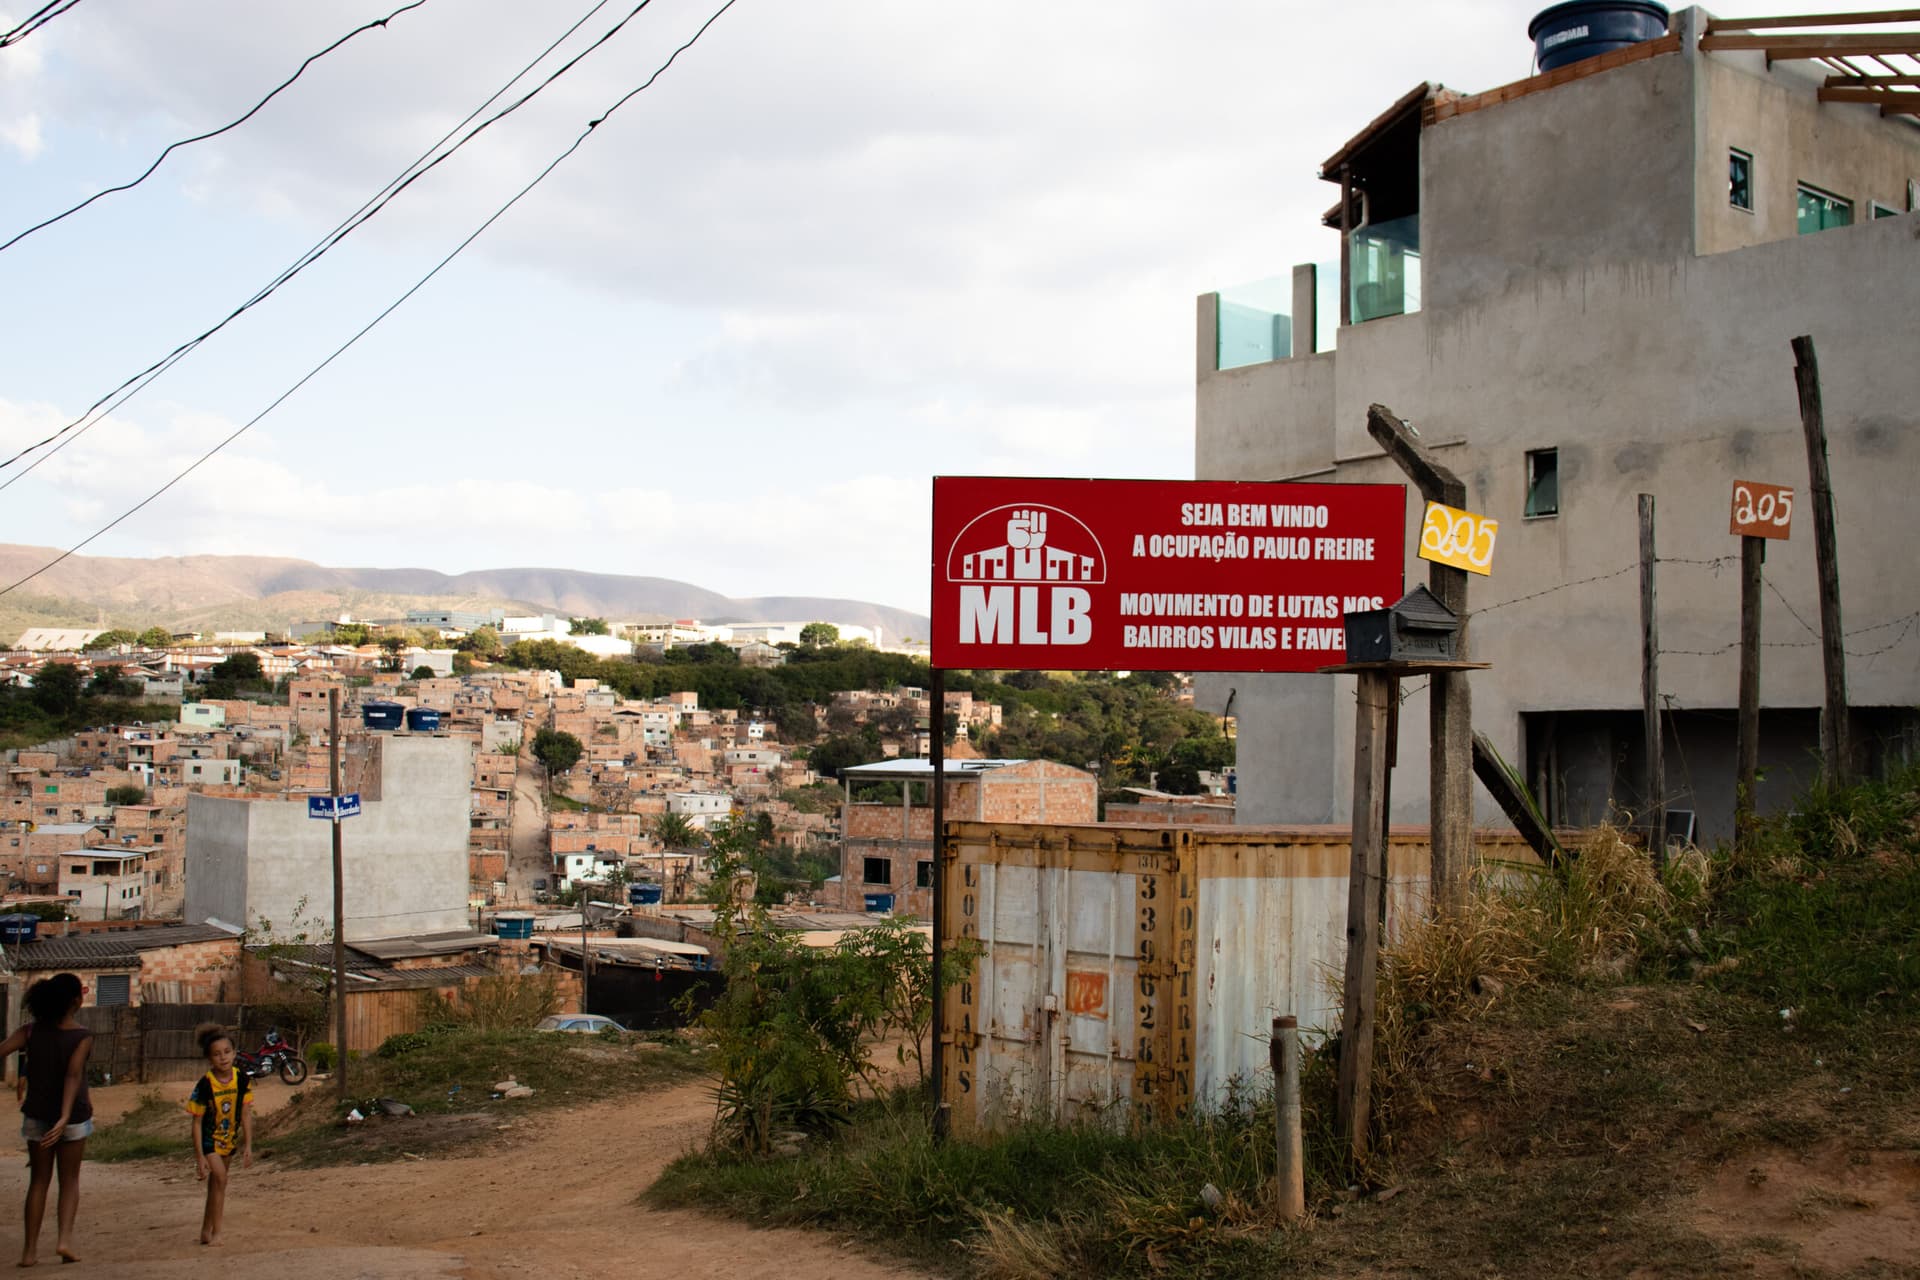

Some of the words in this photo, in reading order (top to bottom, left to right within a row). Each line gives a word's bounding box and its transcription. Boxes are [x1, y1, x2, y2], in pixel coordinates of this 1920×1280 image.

[1181, 502, 1224, 526] SEJA
[1227, 503, 1267, 528] BEM
[1270, 504, 1329, 529] VINDO
[1735, 486, 1794, 527] 205
[1132, 534, 1146, 558] A
[1149, 531, 1250, 563] OCUPAÇÃO
[1253, 536, 1311, 560] PAULO
[1314, 537, 1375, 561] FREIRE
[1423, 503, 1498, 567] 205
[959, 585, 1093, 646] MLB
[1120, 592, 1244, 618] MOVIMENTO
[1248, 594, 1274, 618] DE
[1278, 595, 1339, 619] LUTAS
[1123, 625, 1215, 649] BAIRROS
[1218, 626, 1277, 650] VILAS
[1281, 627, 1292, 650] E
[1296, 627, 1347, 651] FAVE
